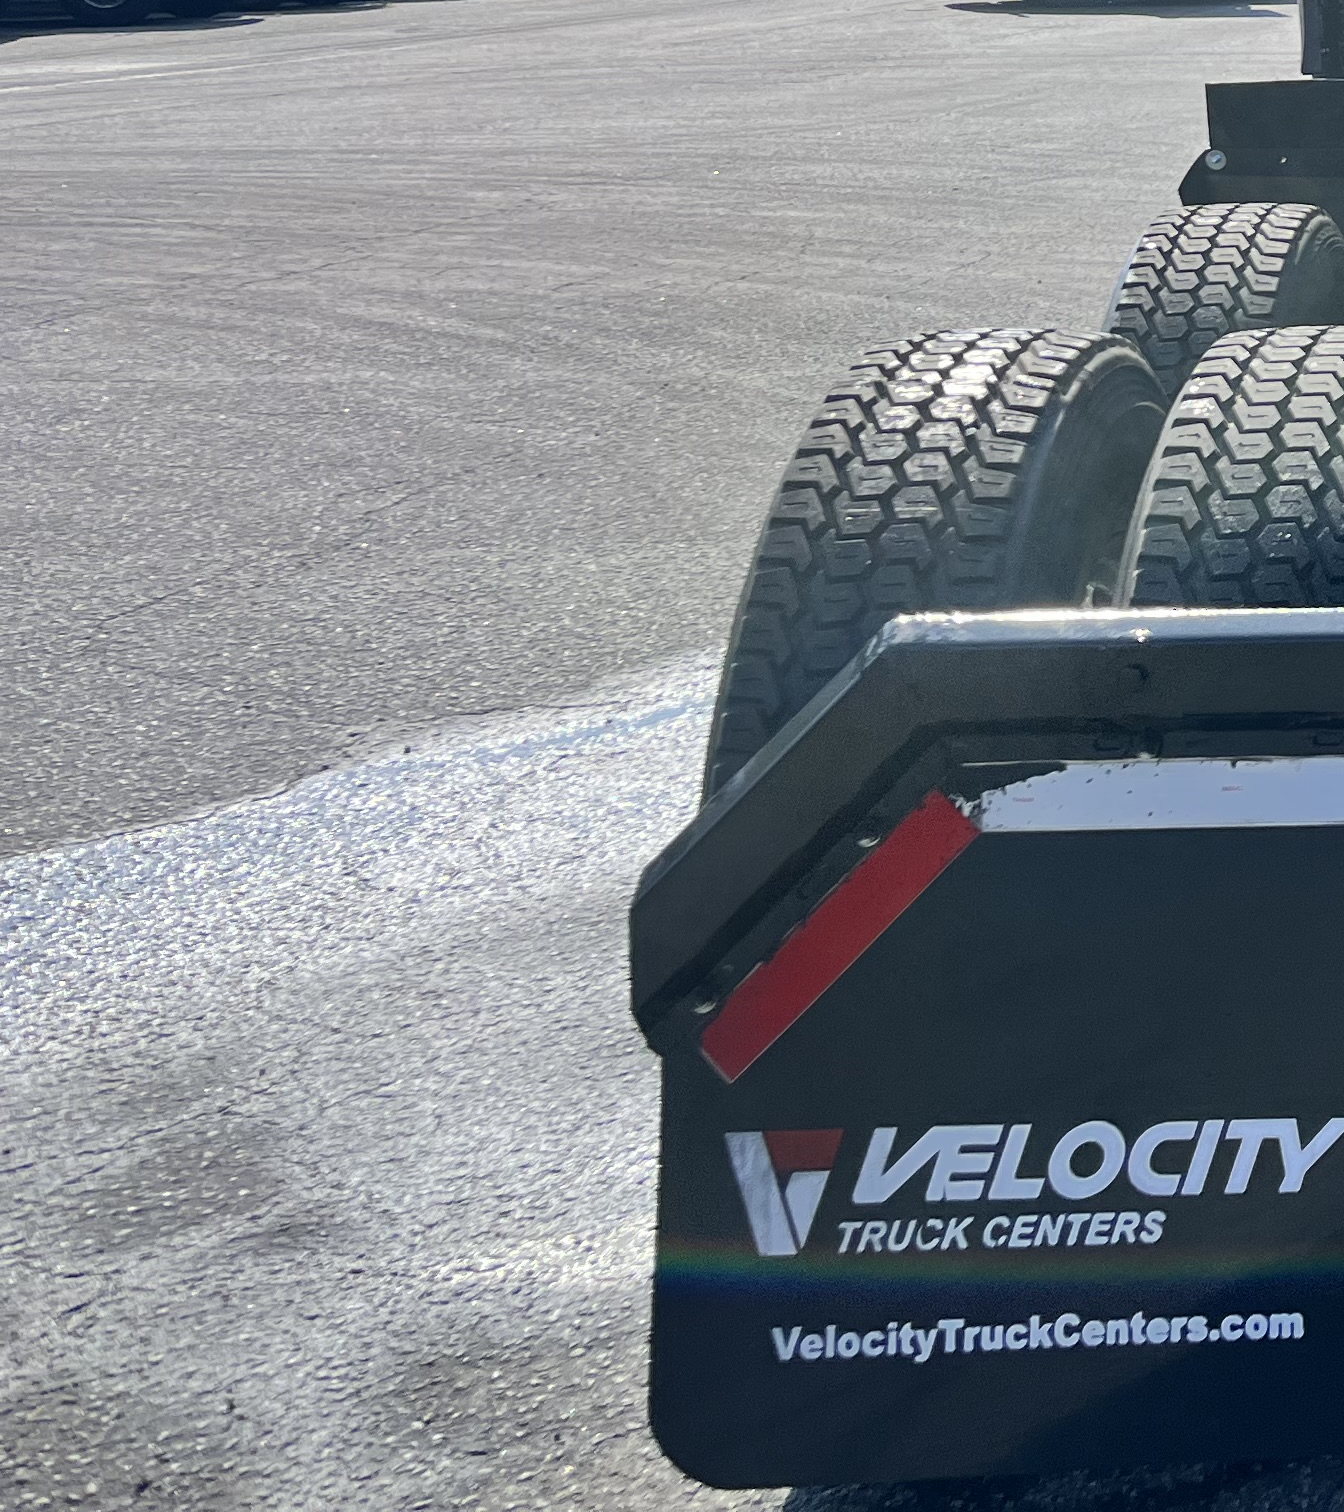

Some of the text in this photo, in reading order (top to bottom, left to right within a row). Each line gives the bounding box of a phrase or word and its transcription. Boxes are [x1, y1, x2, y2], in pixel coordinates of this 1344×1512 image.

[837, 1210, 1168, 1255] TRUCK CENTERS
[771, 1311, 1306, 1363] VelocityTruckCenters.com
